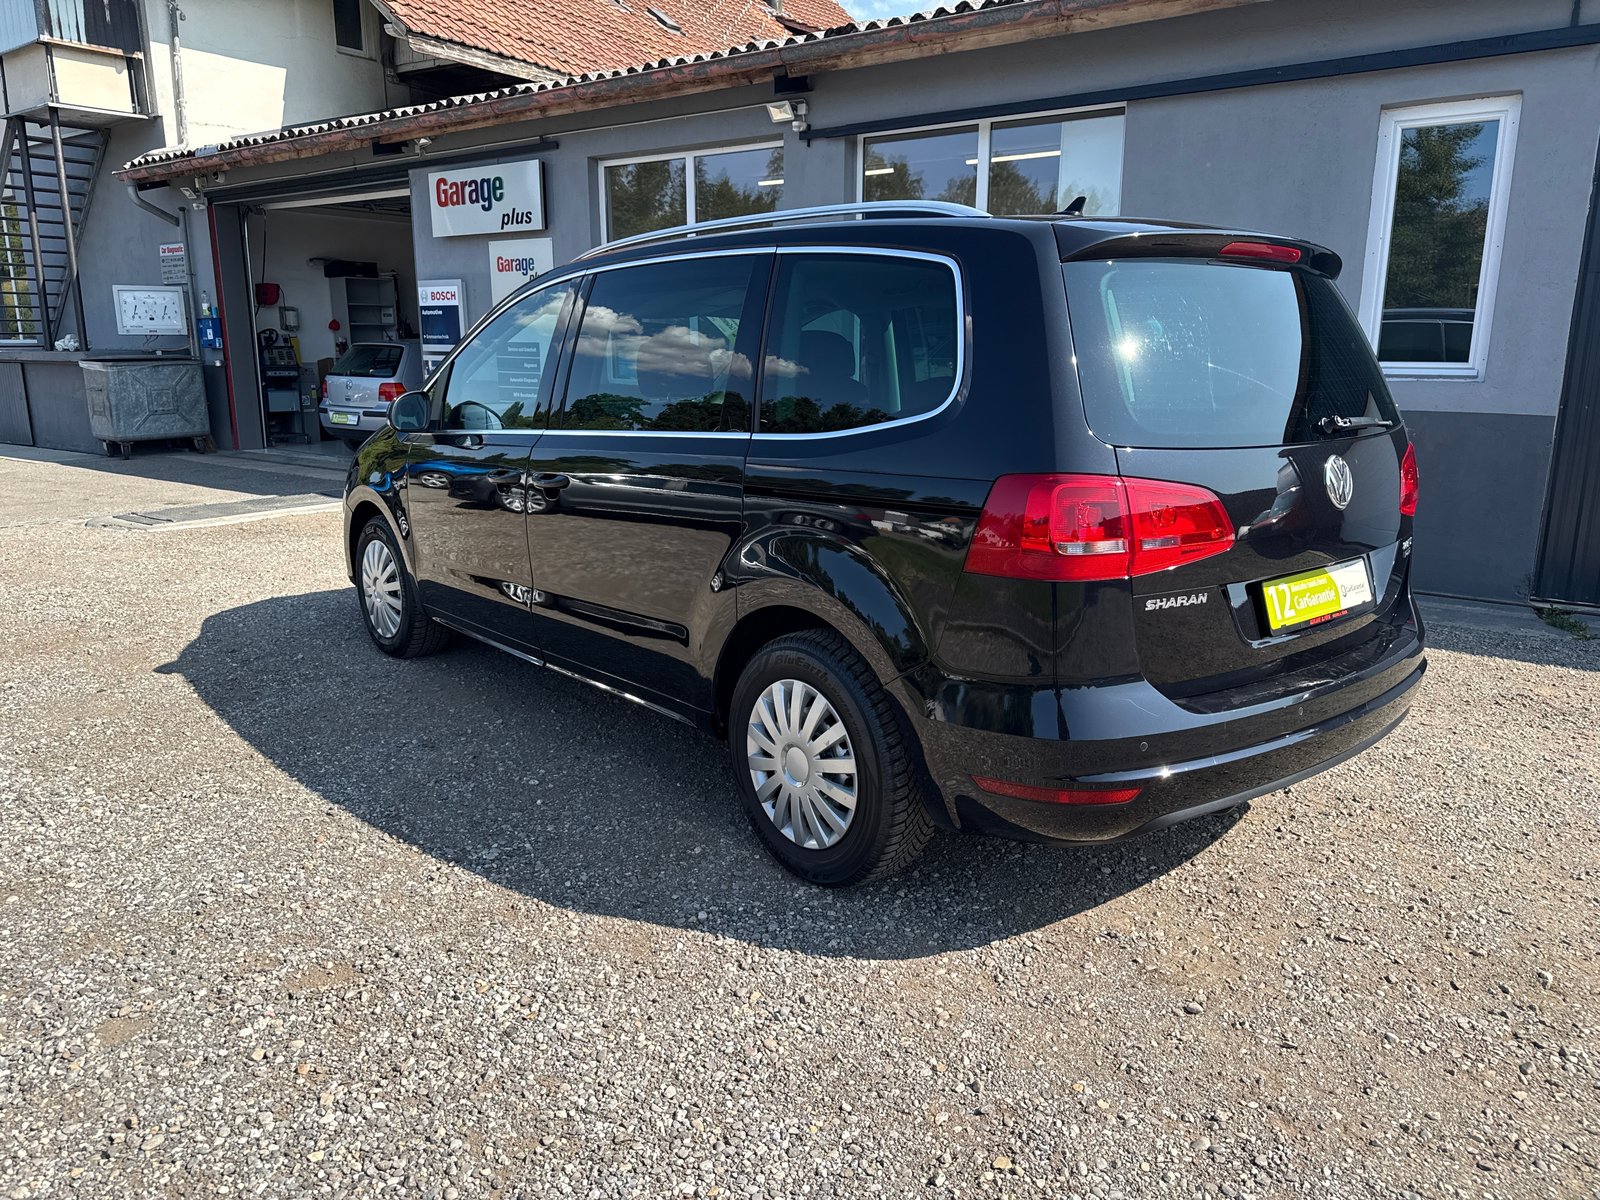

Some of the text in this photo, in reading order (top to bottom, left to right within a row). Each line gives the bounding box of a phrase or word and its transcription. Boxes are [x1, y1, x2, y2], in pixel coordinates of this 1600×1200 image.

[436, 176, 504, 212] Garage
[501, 208, 532, 230] plus
[497, 256, 534, 276] Garage
[430, 291, 456, 301] BOSCH
[1145, 592, 1208, 611] SHARAN
[1267, 583, 1296, 621] 12
[1294, 586, 1337, 611] CarGarantie
